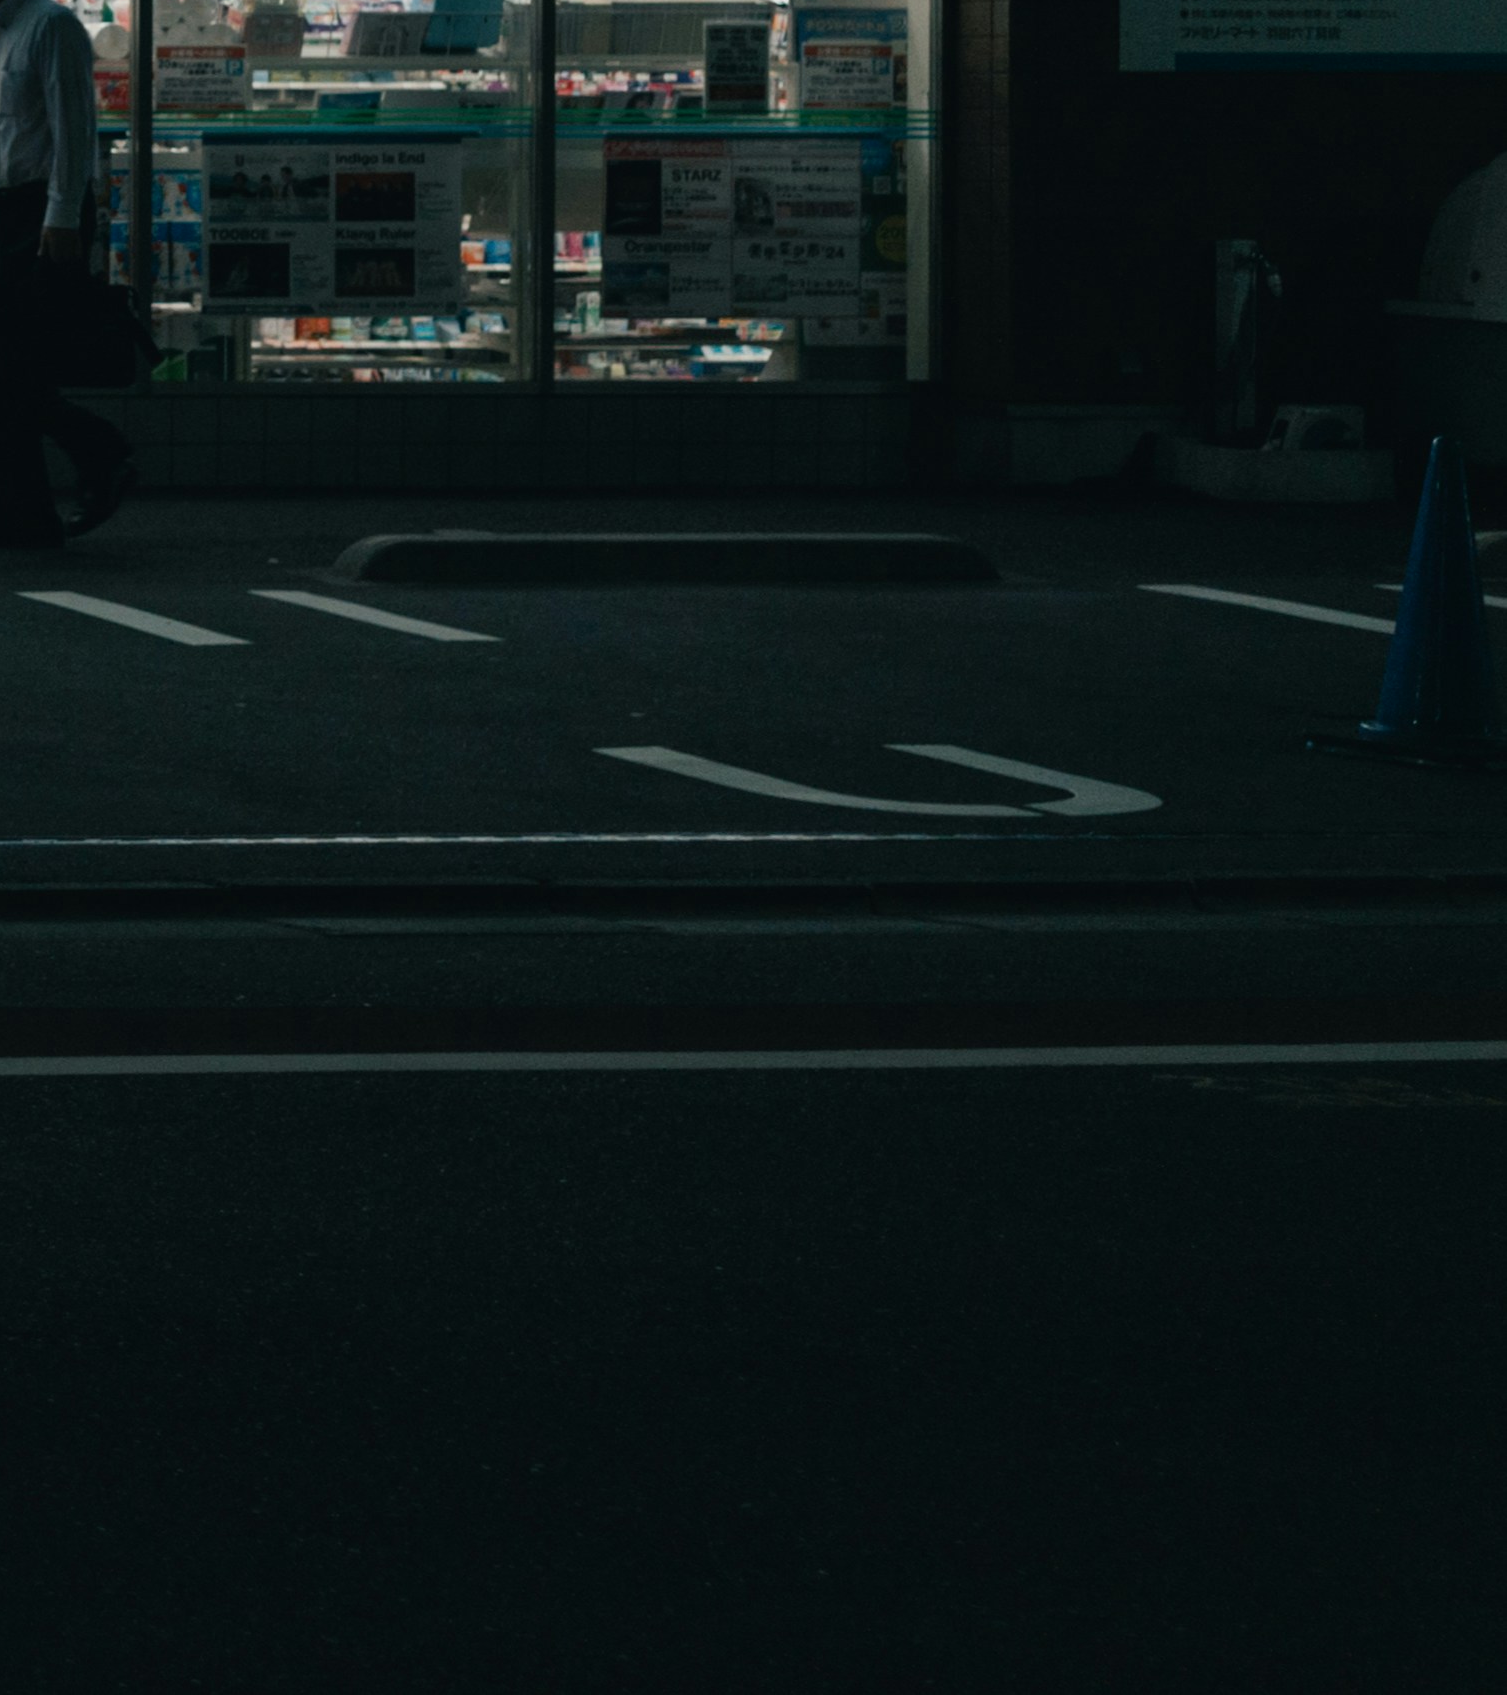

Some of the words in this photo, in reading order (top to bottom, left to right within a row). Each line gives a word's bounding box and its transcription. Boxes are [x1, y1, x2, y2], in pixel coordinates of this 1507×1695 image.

[398, 153, 426, 165] End
[671, 169, 722, 183] STARZ
[209, 228, 270, 241] TOOBOE
[335, 228, 376, 242] Klang
[379, 228, 416, 241] Ruler
[624, 241, 713, 256] Orangestar
